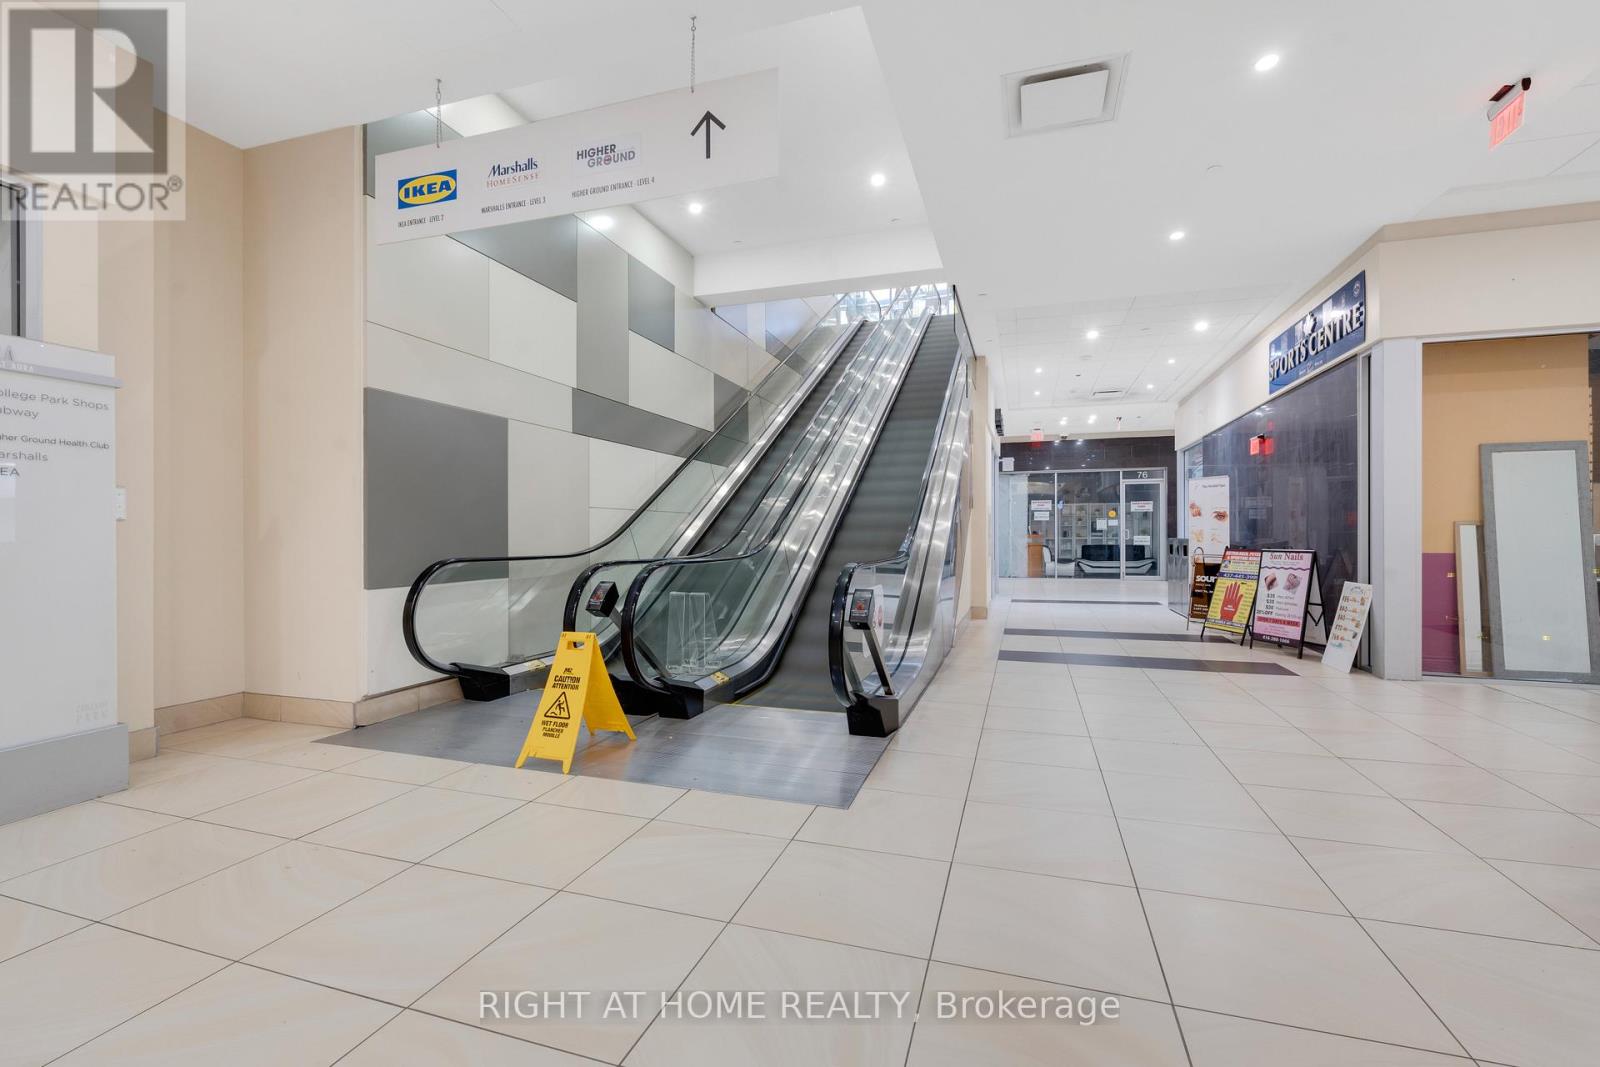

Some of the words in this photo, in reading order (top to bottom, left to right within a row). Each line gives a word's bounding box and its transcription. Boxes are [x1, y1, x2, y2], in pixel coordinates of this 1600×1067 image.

[576, 144, 616, 160] HIGHER
[587, 150, 636, 168] GROUND
[488, 157, 538, 178] Marshalls
[403, 180, 452, 199] IKEA
[571, 188, 589, 198] HIGHER
[589, 184, 609, 195] GROUND
[610, 180, 633, 192] ENTRANCE
[637, 177, 650, 187] LEVEL
[481, 203, 505, 214] MARSHALLS
[505, 199, 526, 210] ENTRANCE
[529, 196, 541, 206] LEVEL
[407, 217, 426, 227] ENTRANCE
[429, 214, 440, 223] LEVEL
[1269, 336, 1308, 381] SPORTS
[1308, 301, 1364, 357] CENTRE
[41, 393, 69, 405] Park
[72, 398, 109, 411] Shops
[20, 434, 57, 445] Ground
[59, 437, 88, 448] Health
[90, 441, 110, 450] Club
[1136, 470, 1149, 479] 76
[1284, 552, 1305, 561] Nails
[554, 675, 580, 684] CAUTION
[553, 720, 569, 729] FLOOR
